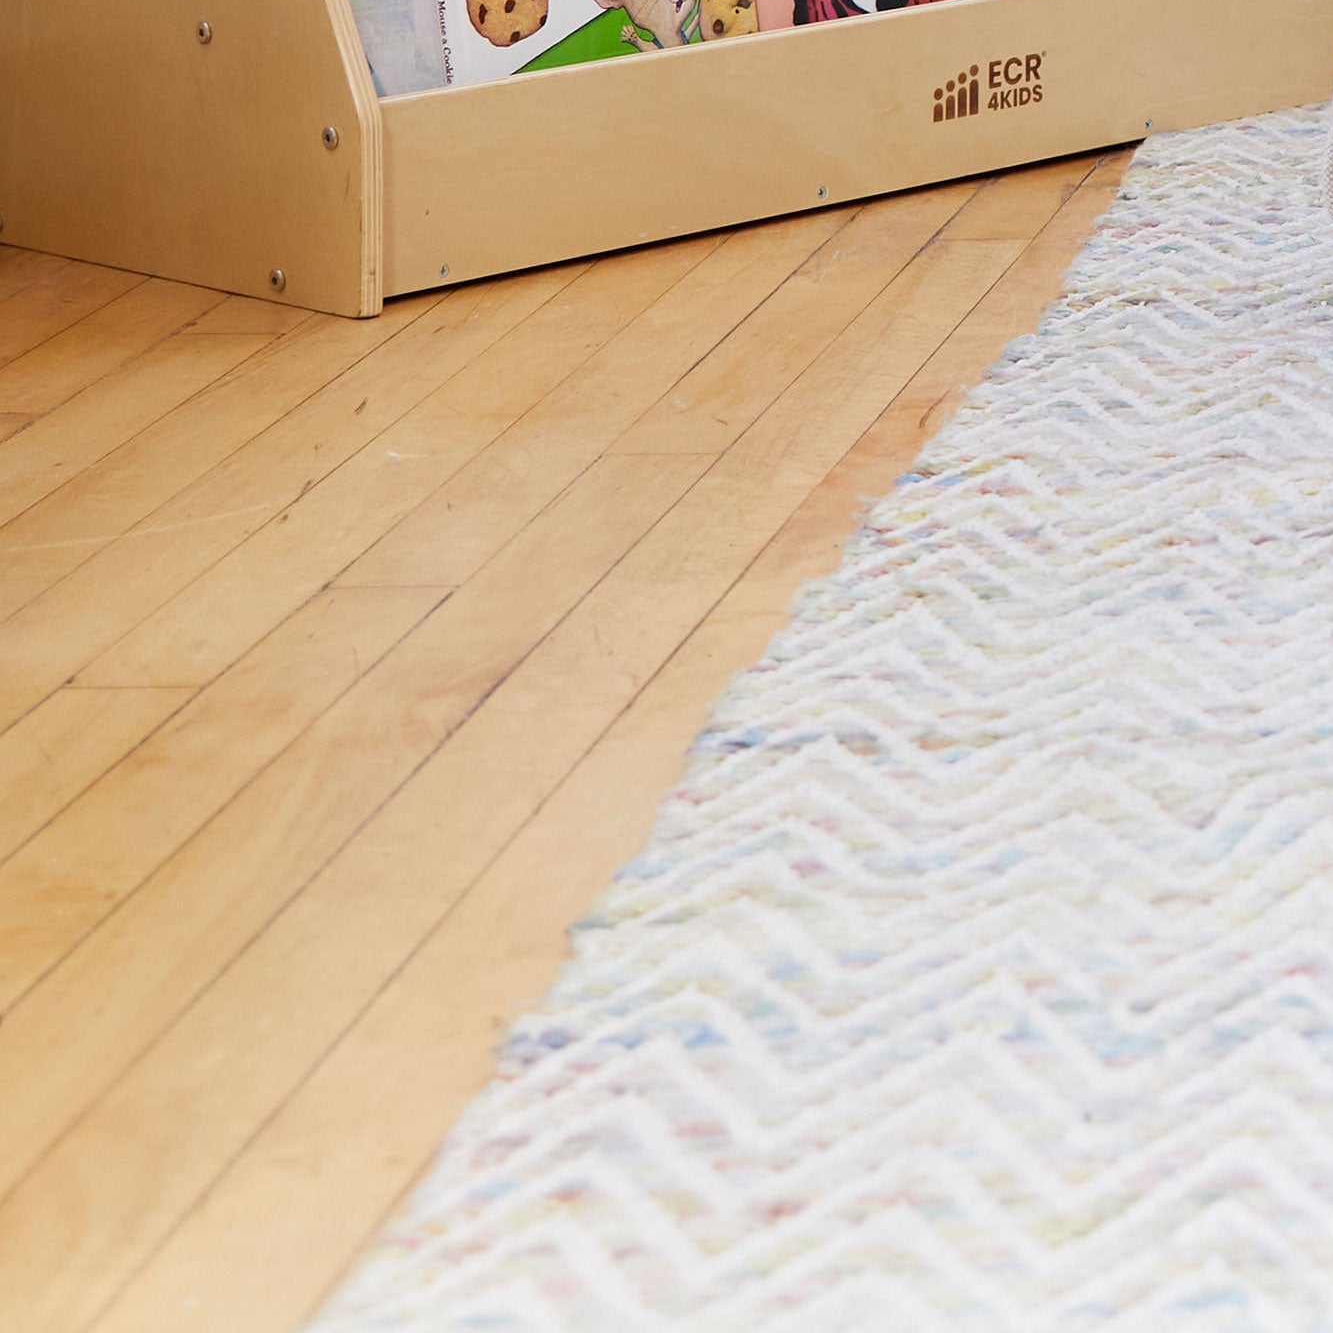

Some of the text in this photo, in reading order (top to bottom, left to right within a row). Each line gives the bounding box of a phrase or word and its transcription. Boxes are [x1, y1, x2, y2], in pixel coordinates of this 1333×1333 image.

[437, 0, 447, 35] Mouse
[443, 47, 452, 84] Cookie
[989, 53, 1042, 89] ECR
[987, 84, 1043, 111] 4KIDS
